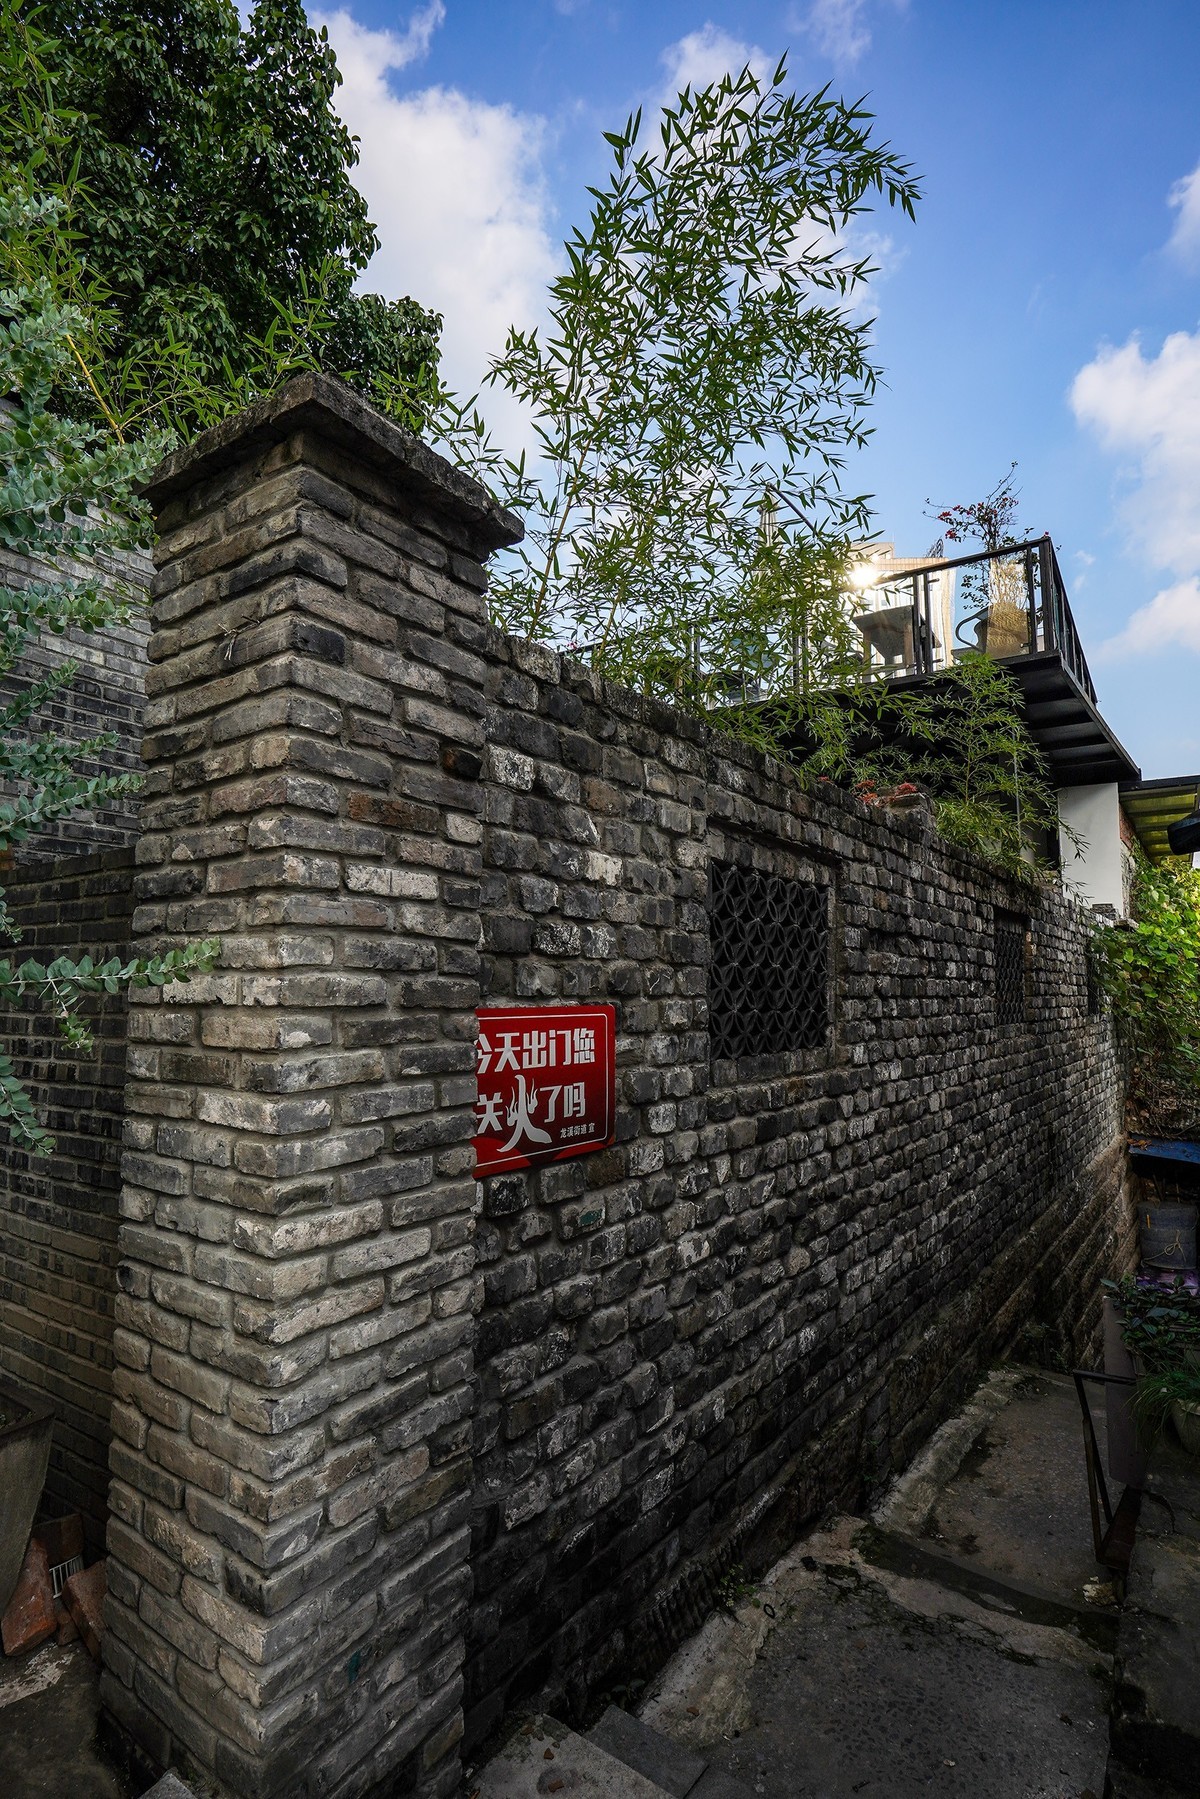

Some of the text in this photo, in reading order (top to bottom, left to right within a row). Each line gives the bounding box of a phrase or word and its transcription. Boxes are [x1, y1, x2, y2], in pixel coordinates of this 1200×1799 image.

[475, 1028, 596, 1075] 今天出门您
[476, 1075, 587, 1153] 关火了吗
